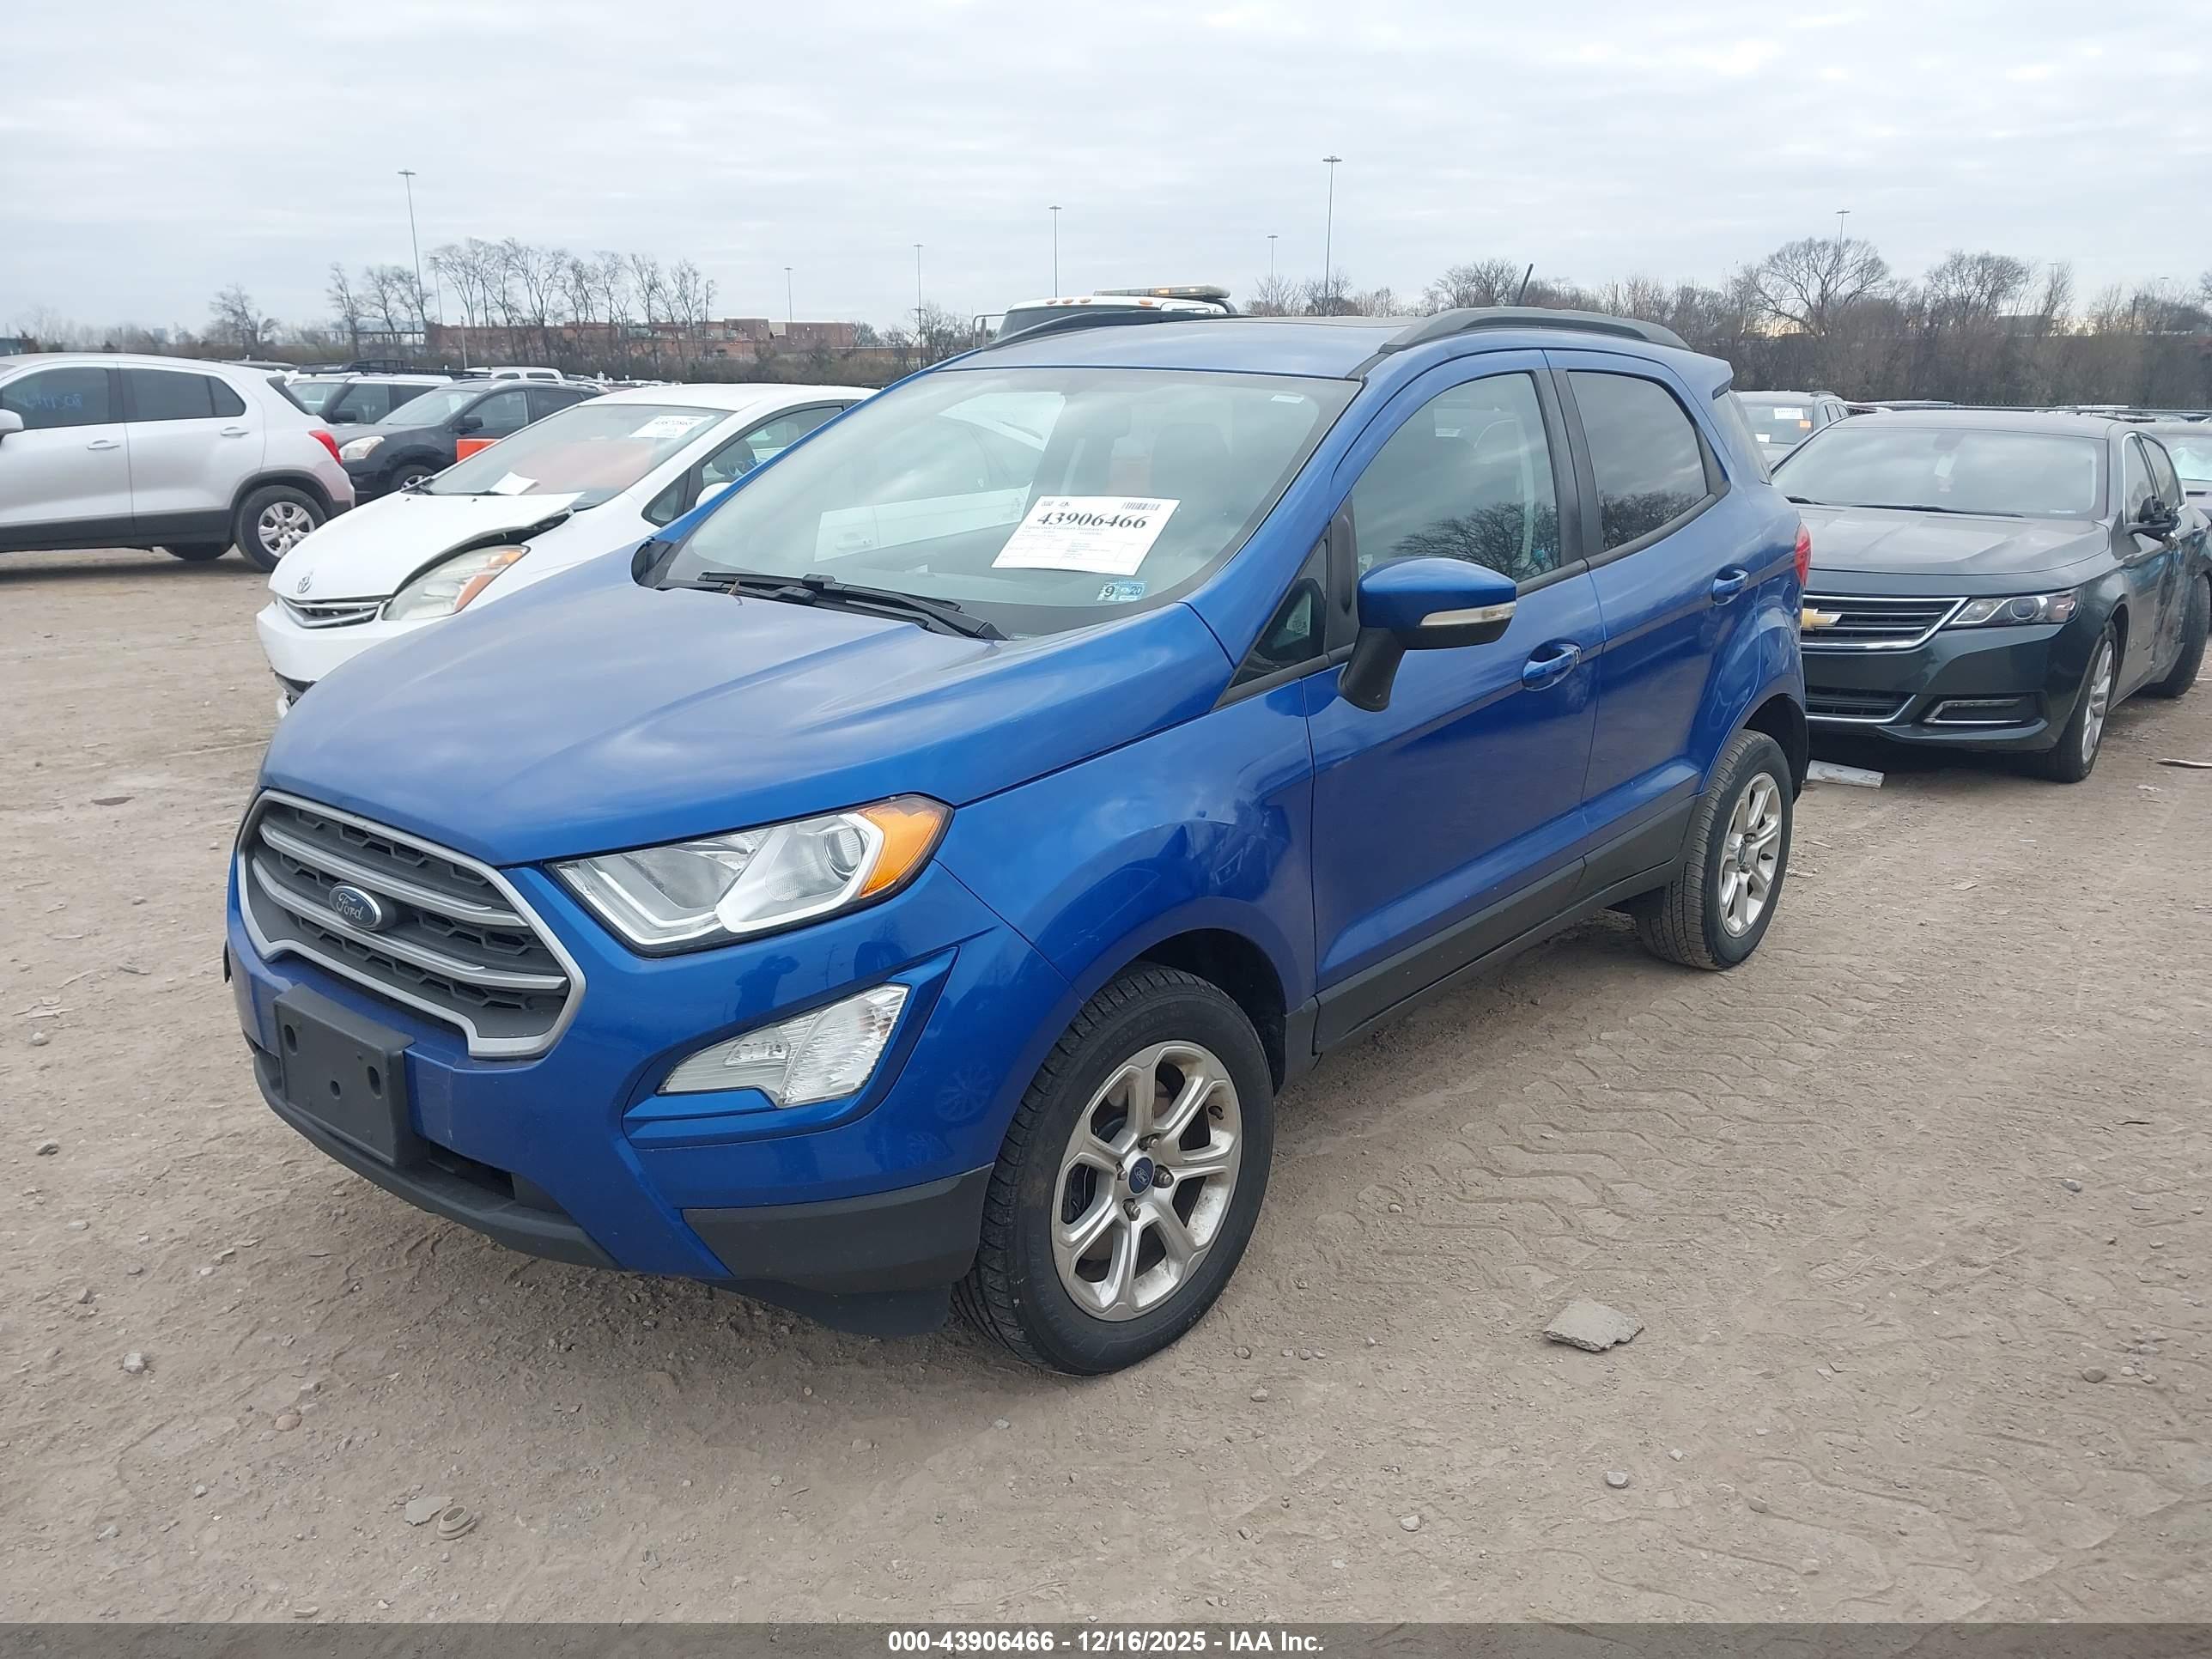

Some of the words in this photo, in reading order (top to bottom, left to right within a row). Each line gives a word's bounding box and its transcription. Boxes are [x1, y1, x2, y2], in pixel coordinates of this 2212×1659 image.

[1036, 512, 1150, 529] 43906466
[1103, 585, 1115, 598] 9
[1128, 585, 1143, 595] 20
[336, 892, 365, 921] Ford
